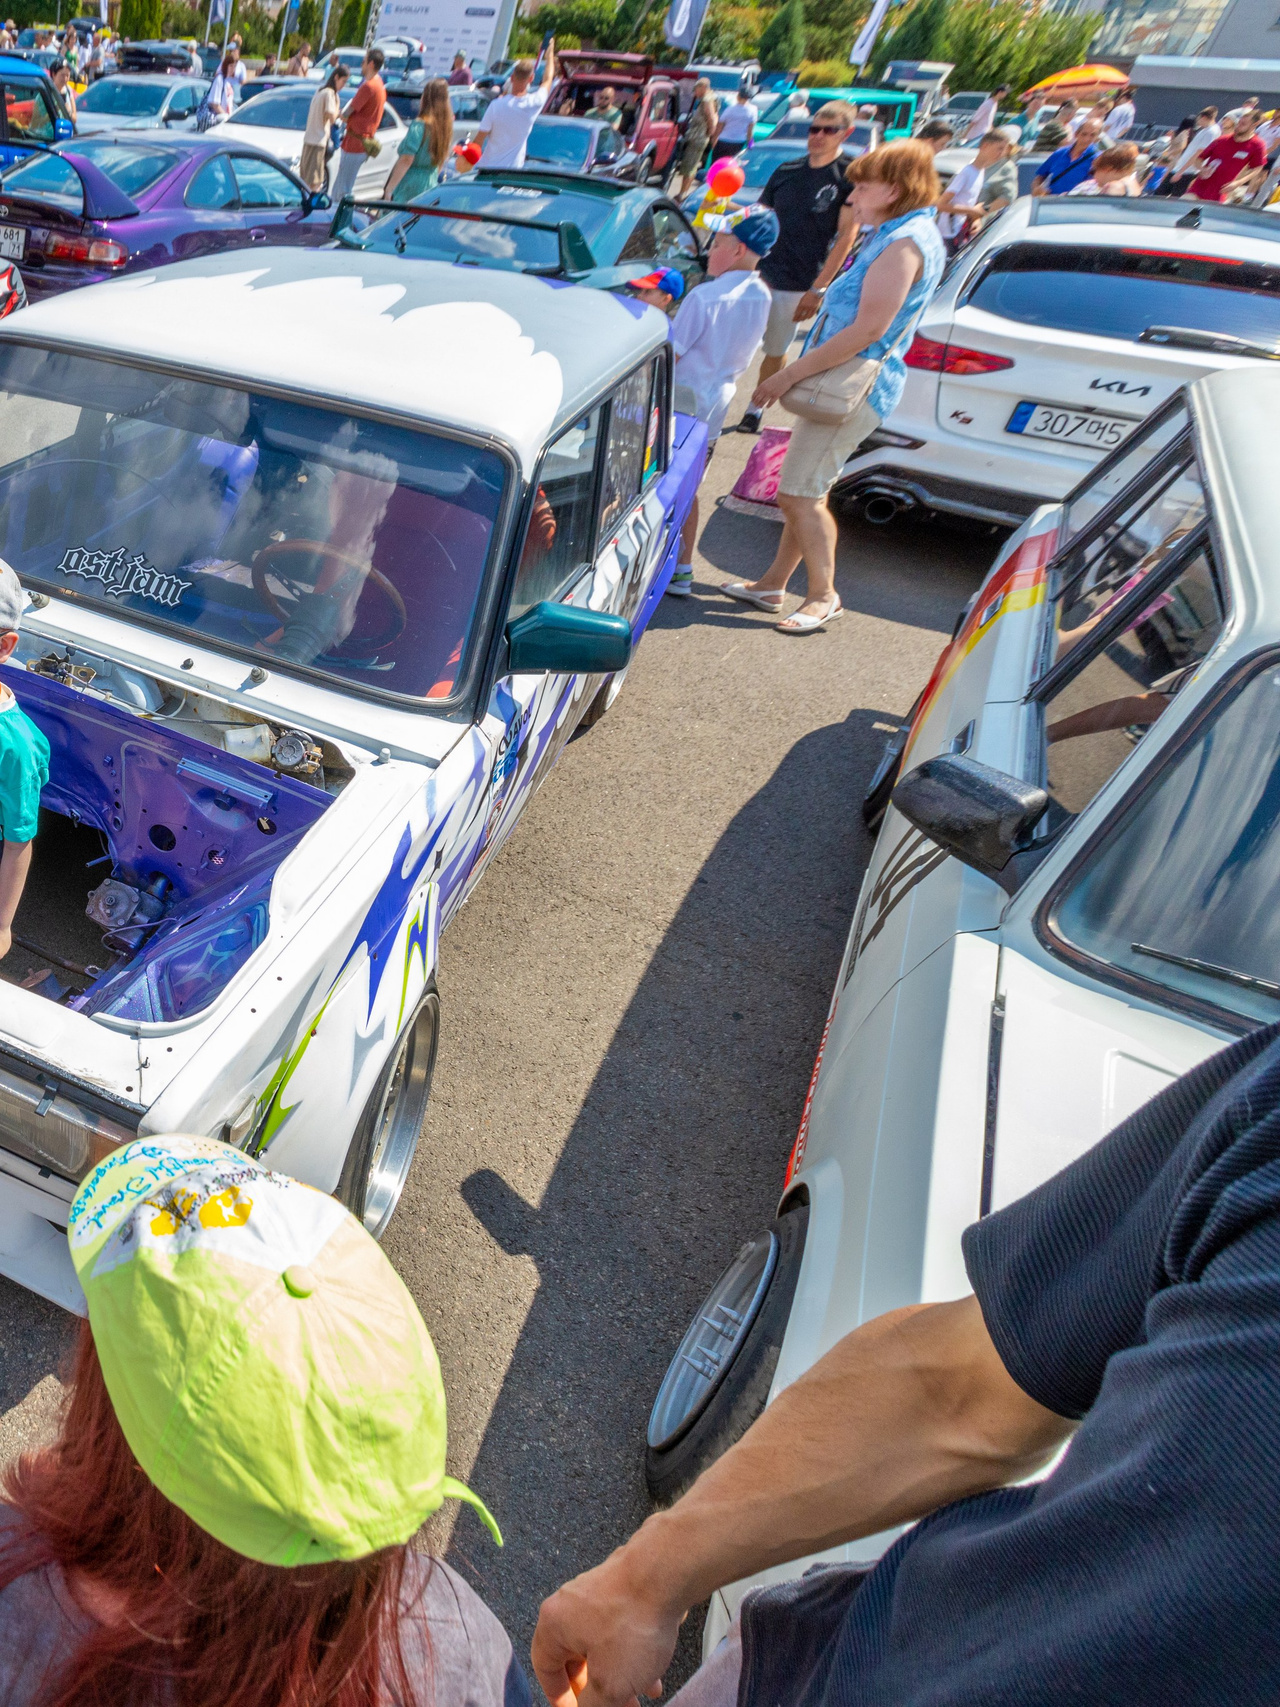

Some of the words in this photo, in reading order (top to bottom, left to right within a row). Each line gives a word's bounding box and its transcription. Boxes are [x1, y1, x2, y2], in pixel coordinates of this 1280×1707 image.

[3, 227, 20, 241] 681
[11, 243, 21, 254] 71
[1089, 377, 1152, 398] KIA
[56, 546, 127, 583] ost
[105, 554, 193, 607] jam
